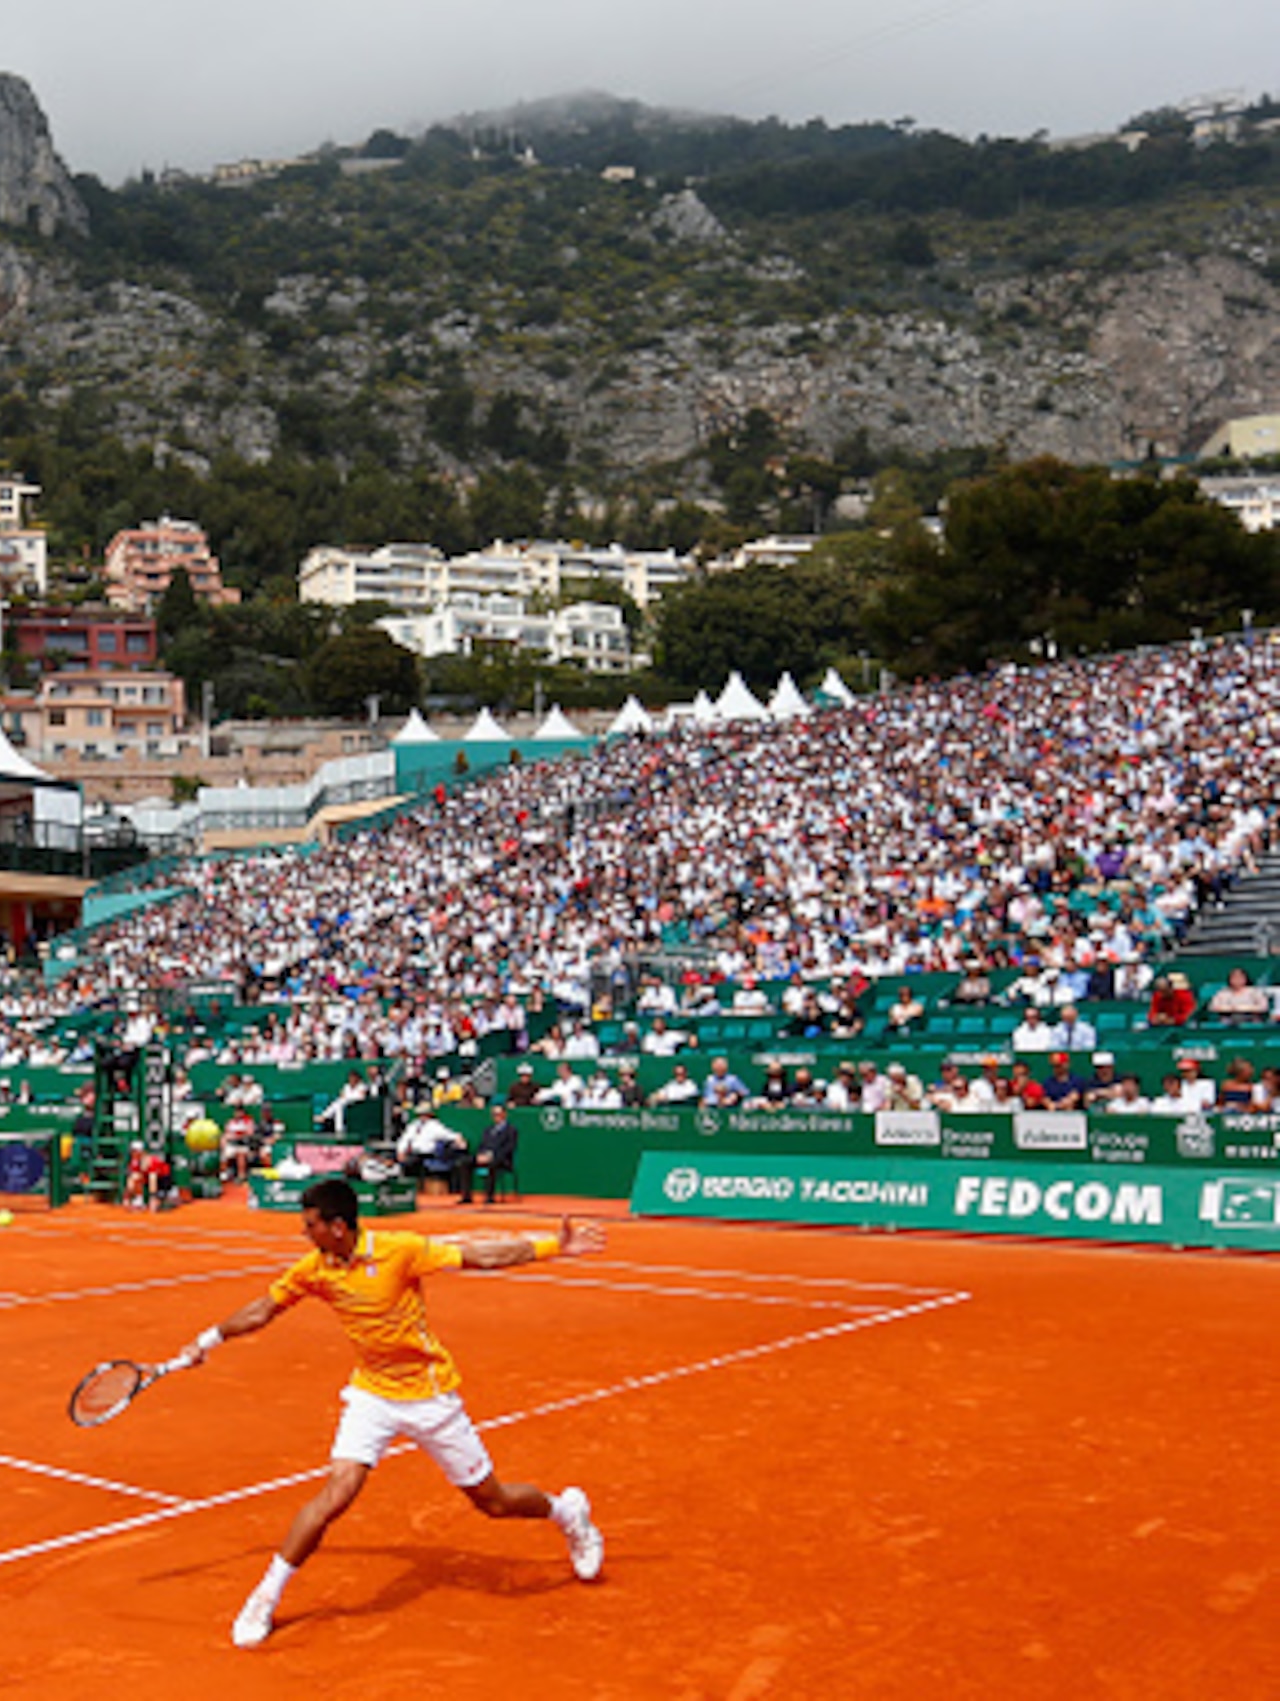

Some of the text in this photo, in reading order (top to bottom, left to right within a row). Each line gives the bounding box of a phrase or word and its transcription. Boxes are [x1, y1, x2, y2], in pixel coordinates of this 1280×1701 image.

[702, 1176, 929, 1206] SERGIO TACCHINI
[954, 1176, 1163, 1224] FEDCOM
